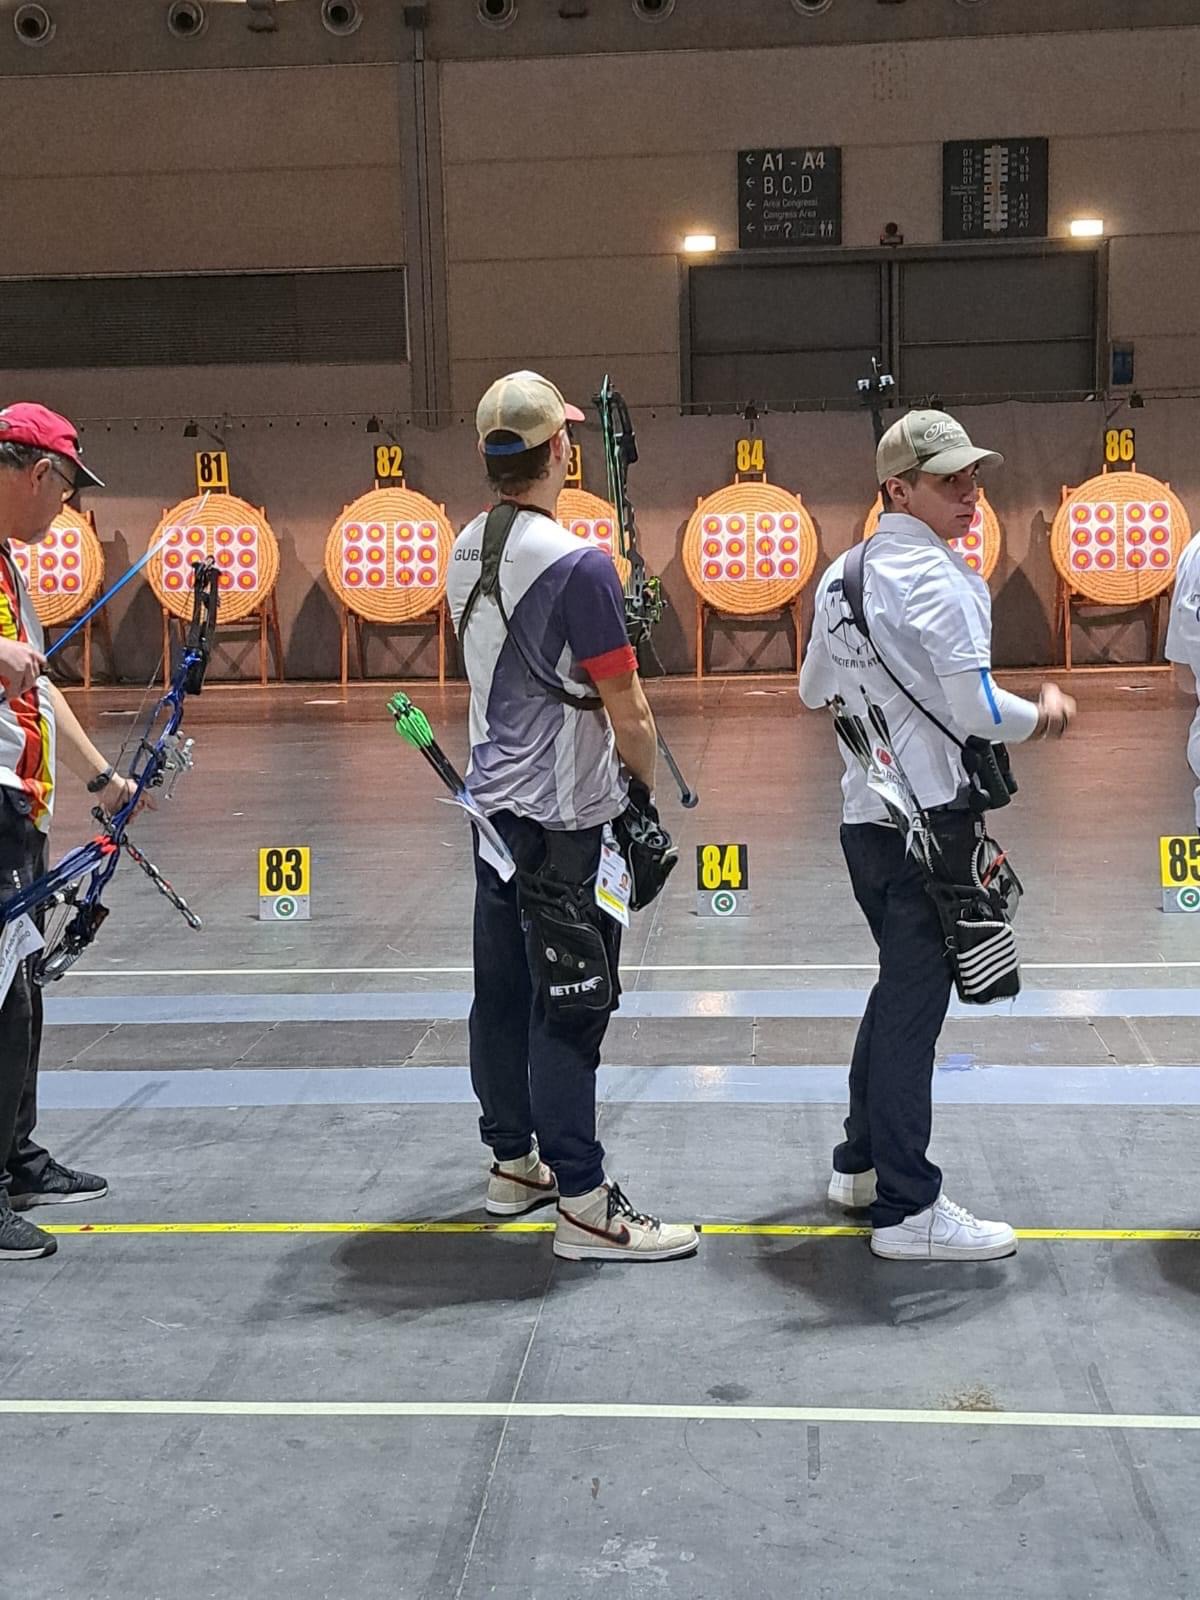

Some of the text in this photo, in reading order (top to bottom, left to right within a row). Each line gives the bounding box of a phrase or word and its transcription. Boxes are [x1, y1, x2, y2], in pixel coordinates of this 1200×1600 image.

[762, 152, 783, 172] A1
[802, 151, 826, 170] A4
[801, 175, 813, 193] D
[763, 209, 817, 220] Congress Area
[376, 445, 403, 477] 82
[567, 446, 578, 476] 3
[737, 439, 765, 472] 84
[1106, 429, 1134, 462] 86
[200, 453, 222, 482] 81
[266, 849, 302, 892] 83
[702, 845, 742, 889] 84
[1168, 838, 1200, 882] 85
